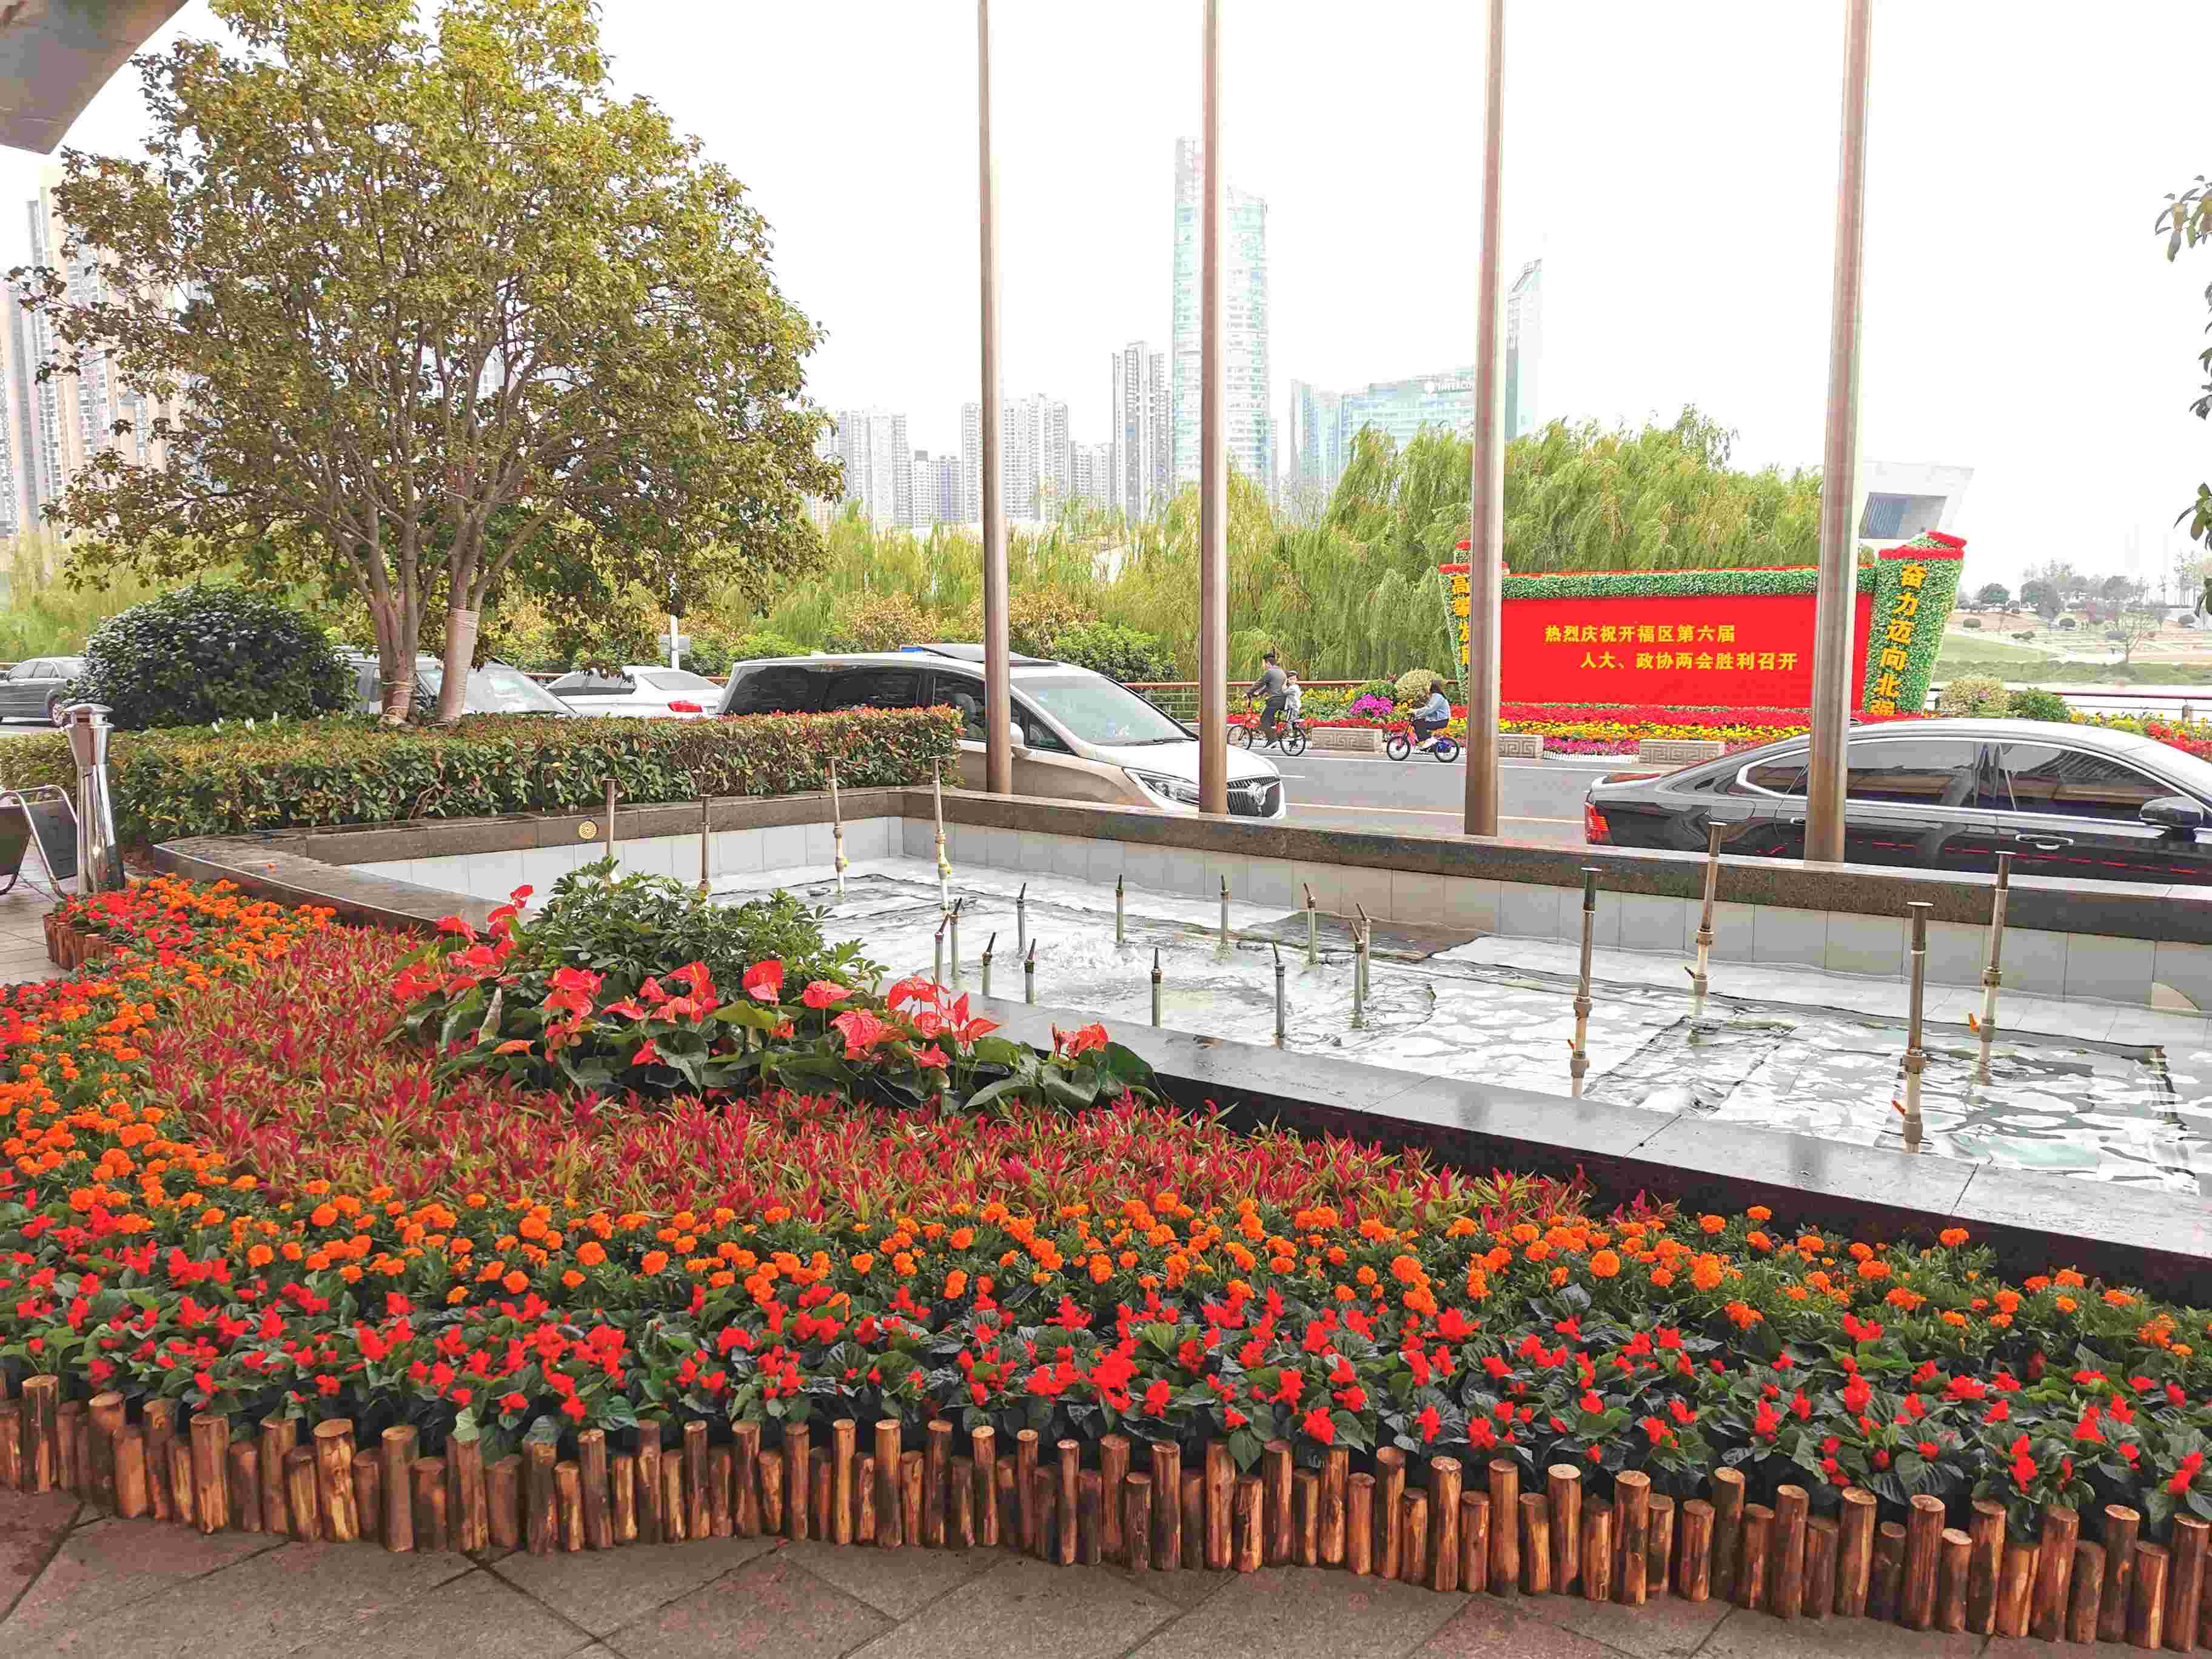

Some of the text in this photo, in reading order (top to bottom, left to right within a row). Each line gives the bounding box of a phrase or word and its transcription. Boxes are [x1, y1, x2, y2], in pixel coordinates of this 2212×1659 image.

[1544, 625, 1735, 643] 热烈庆祝开福区第六届
[1869, 563, 1927, 717] 奋力迈向北强
[1581, 651, 1797, 670] 人大、政协两会胜利召开
